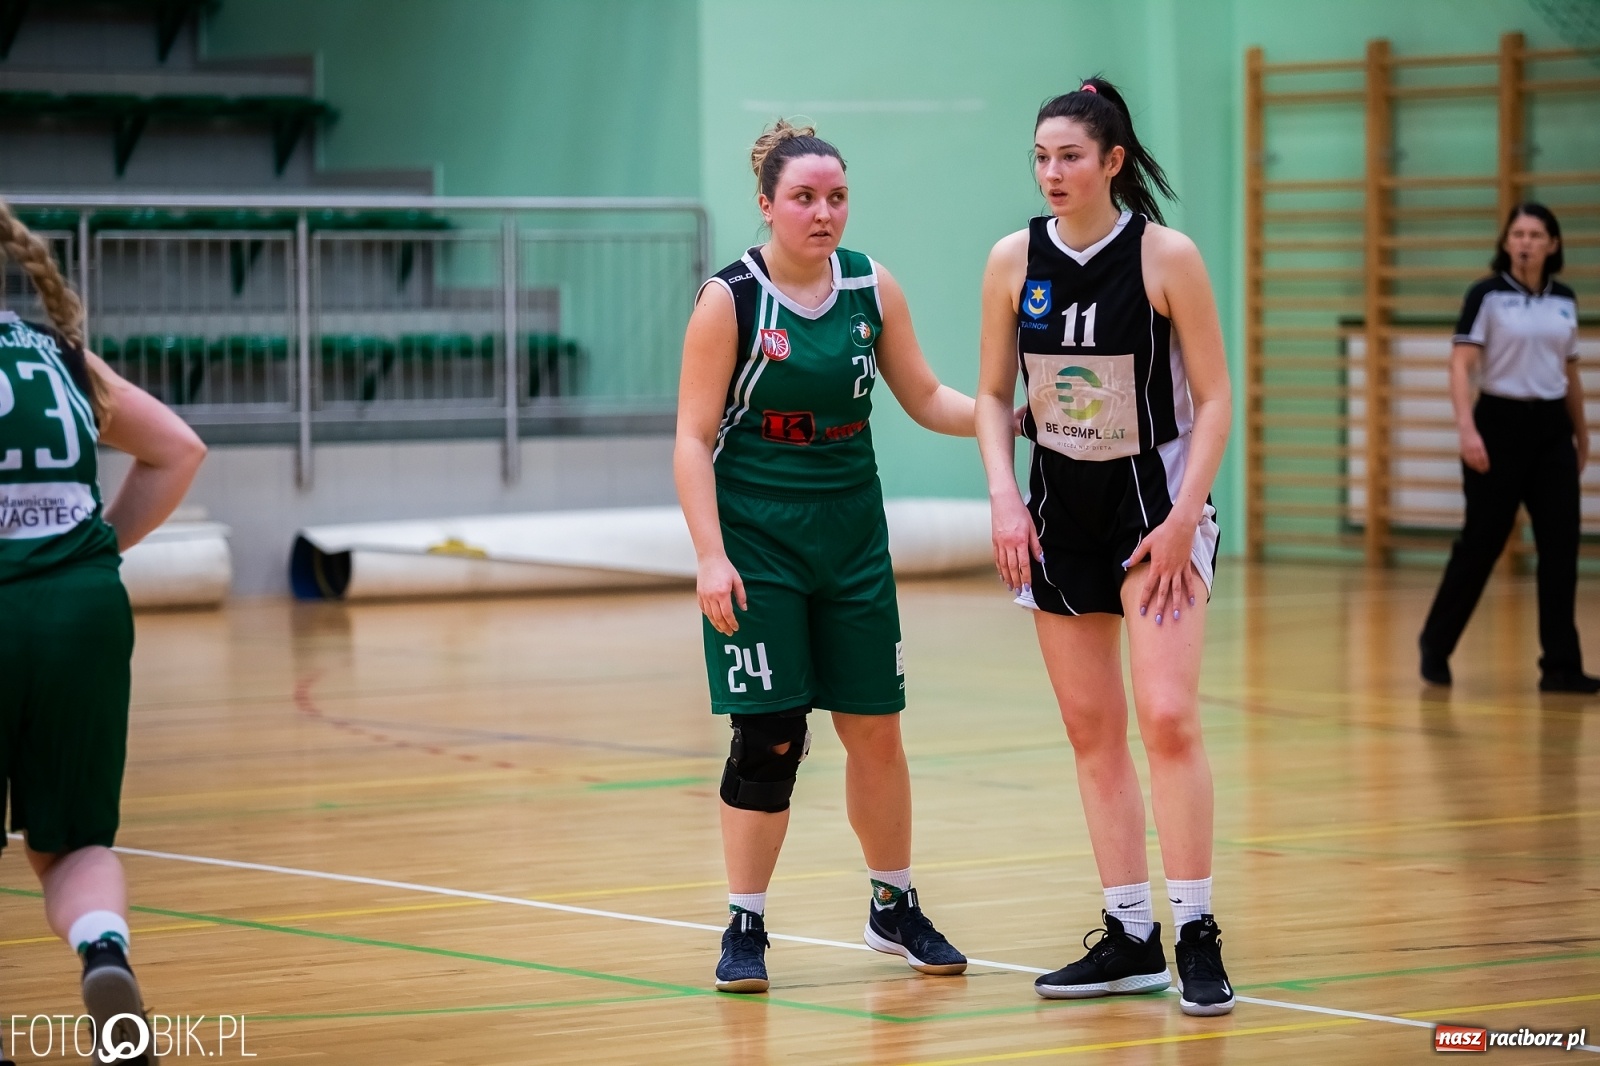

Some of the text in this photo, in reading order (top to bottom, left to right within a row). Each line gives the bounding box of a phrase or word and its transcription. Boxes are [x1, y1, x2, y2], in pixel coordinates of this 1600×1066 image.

[1061, 302, 1097, 347] 11
[1045, 422, 1126, 440] BE COMPLEAT
[0, 495, 65, 508] dawnictwo
[724, 642, 773, 693] 24
